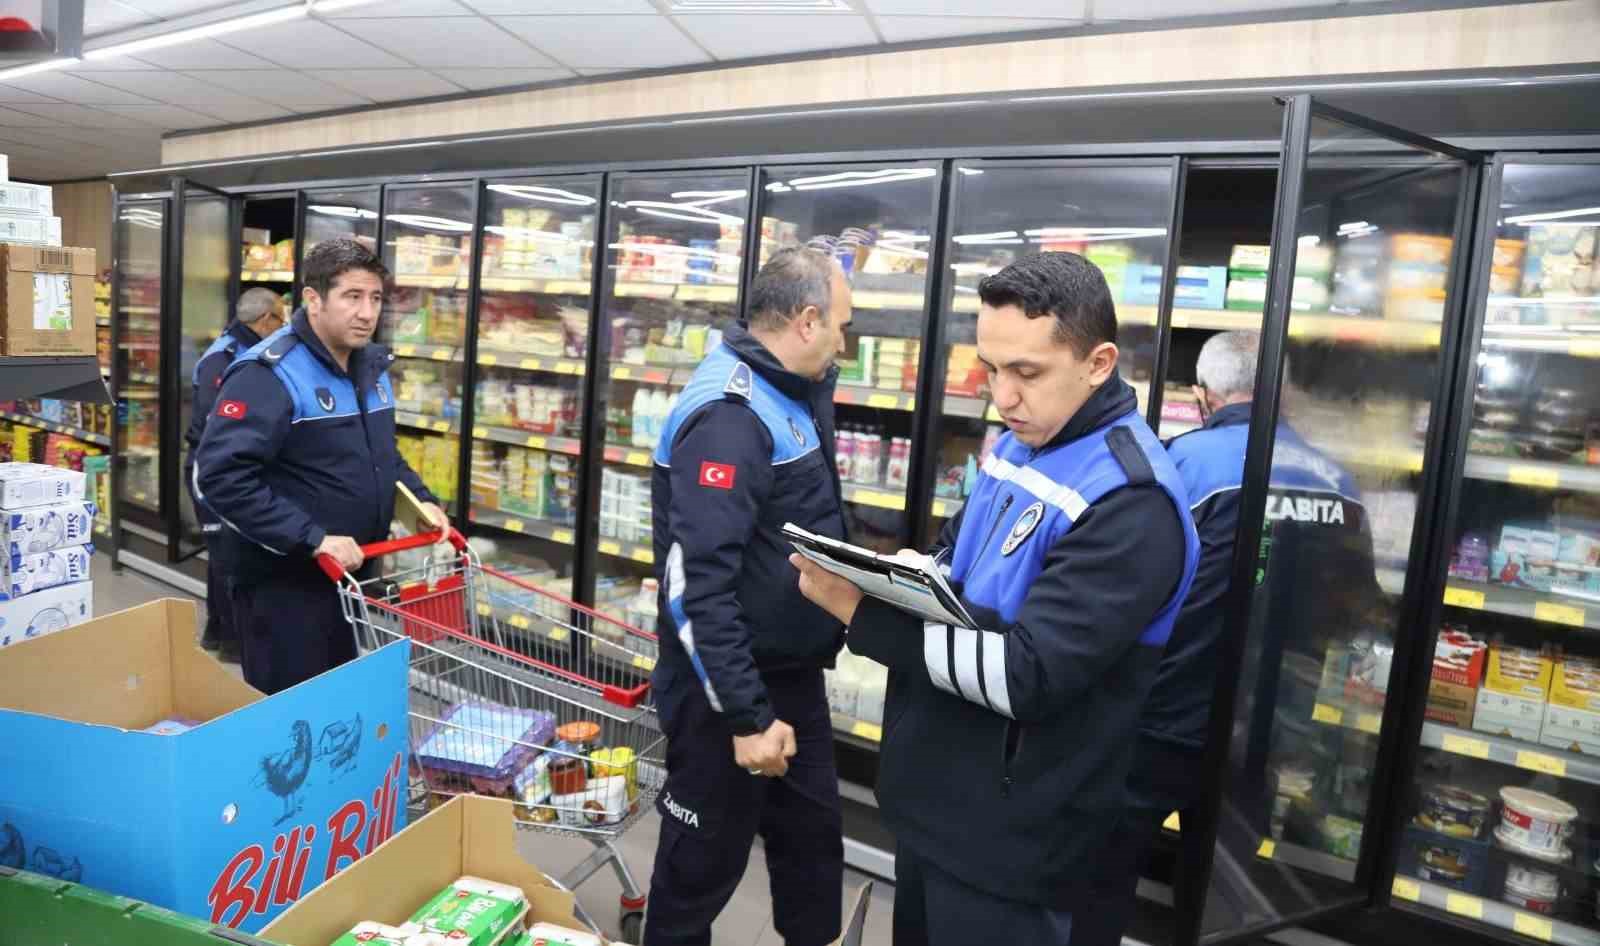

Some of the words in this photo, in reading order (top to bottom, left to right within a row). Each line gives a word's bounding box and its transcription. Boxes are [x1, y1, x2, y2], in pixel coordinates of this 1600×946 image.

[66, 512, 79, 540] Süt
[663, 791, 699, 829] ZABITA
[207, 823, 317, 930] Bili
